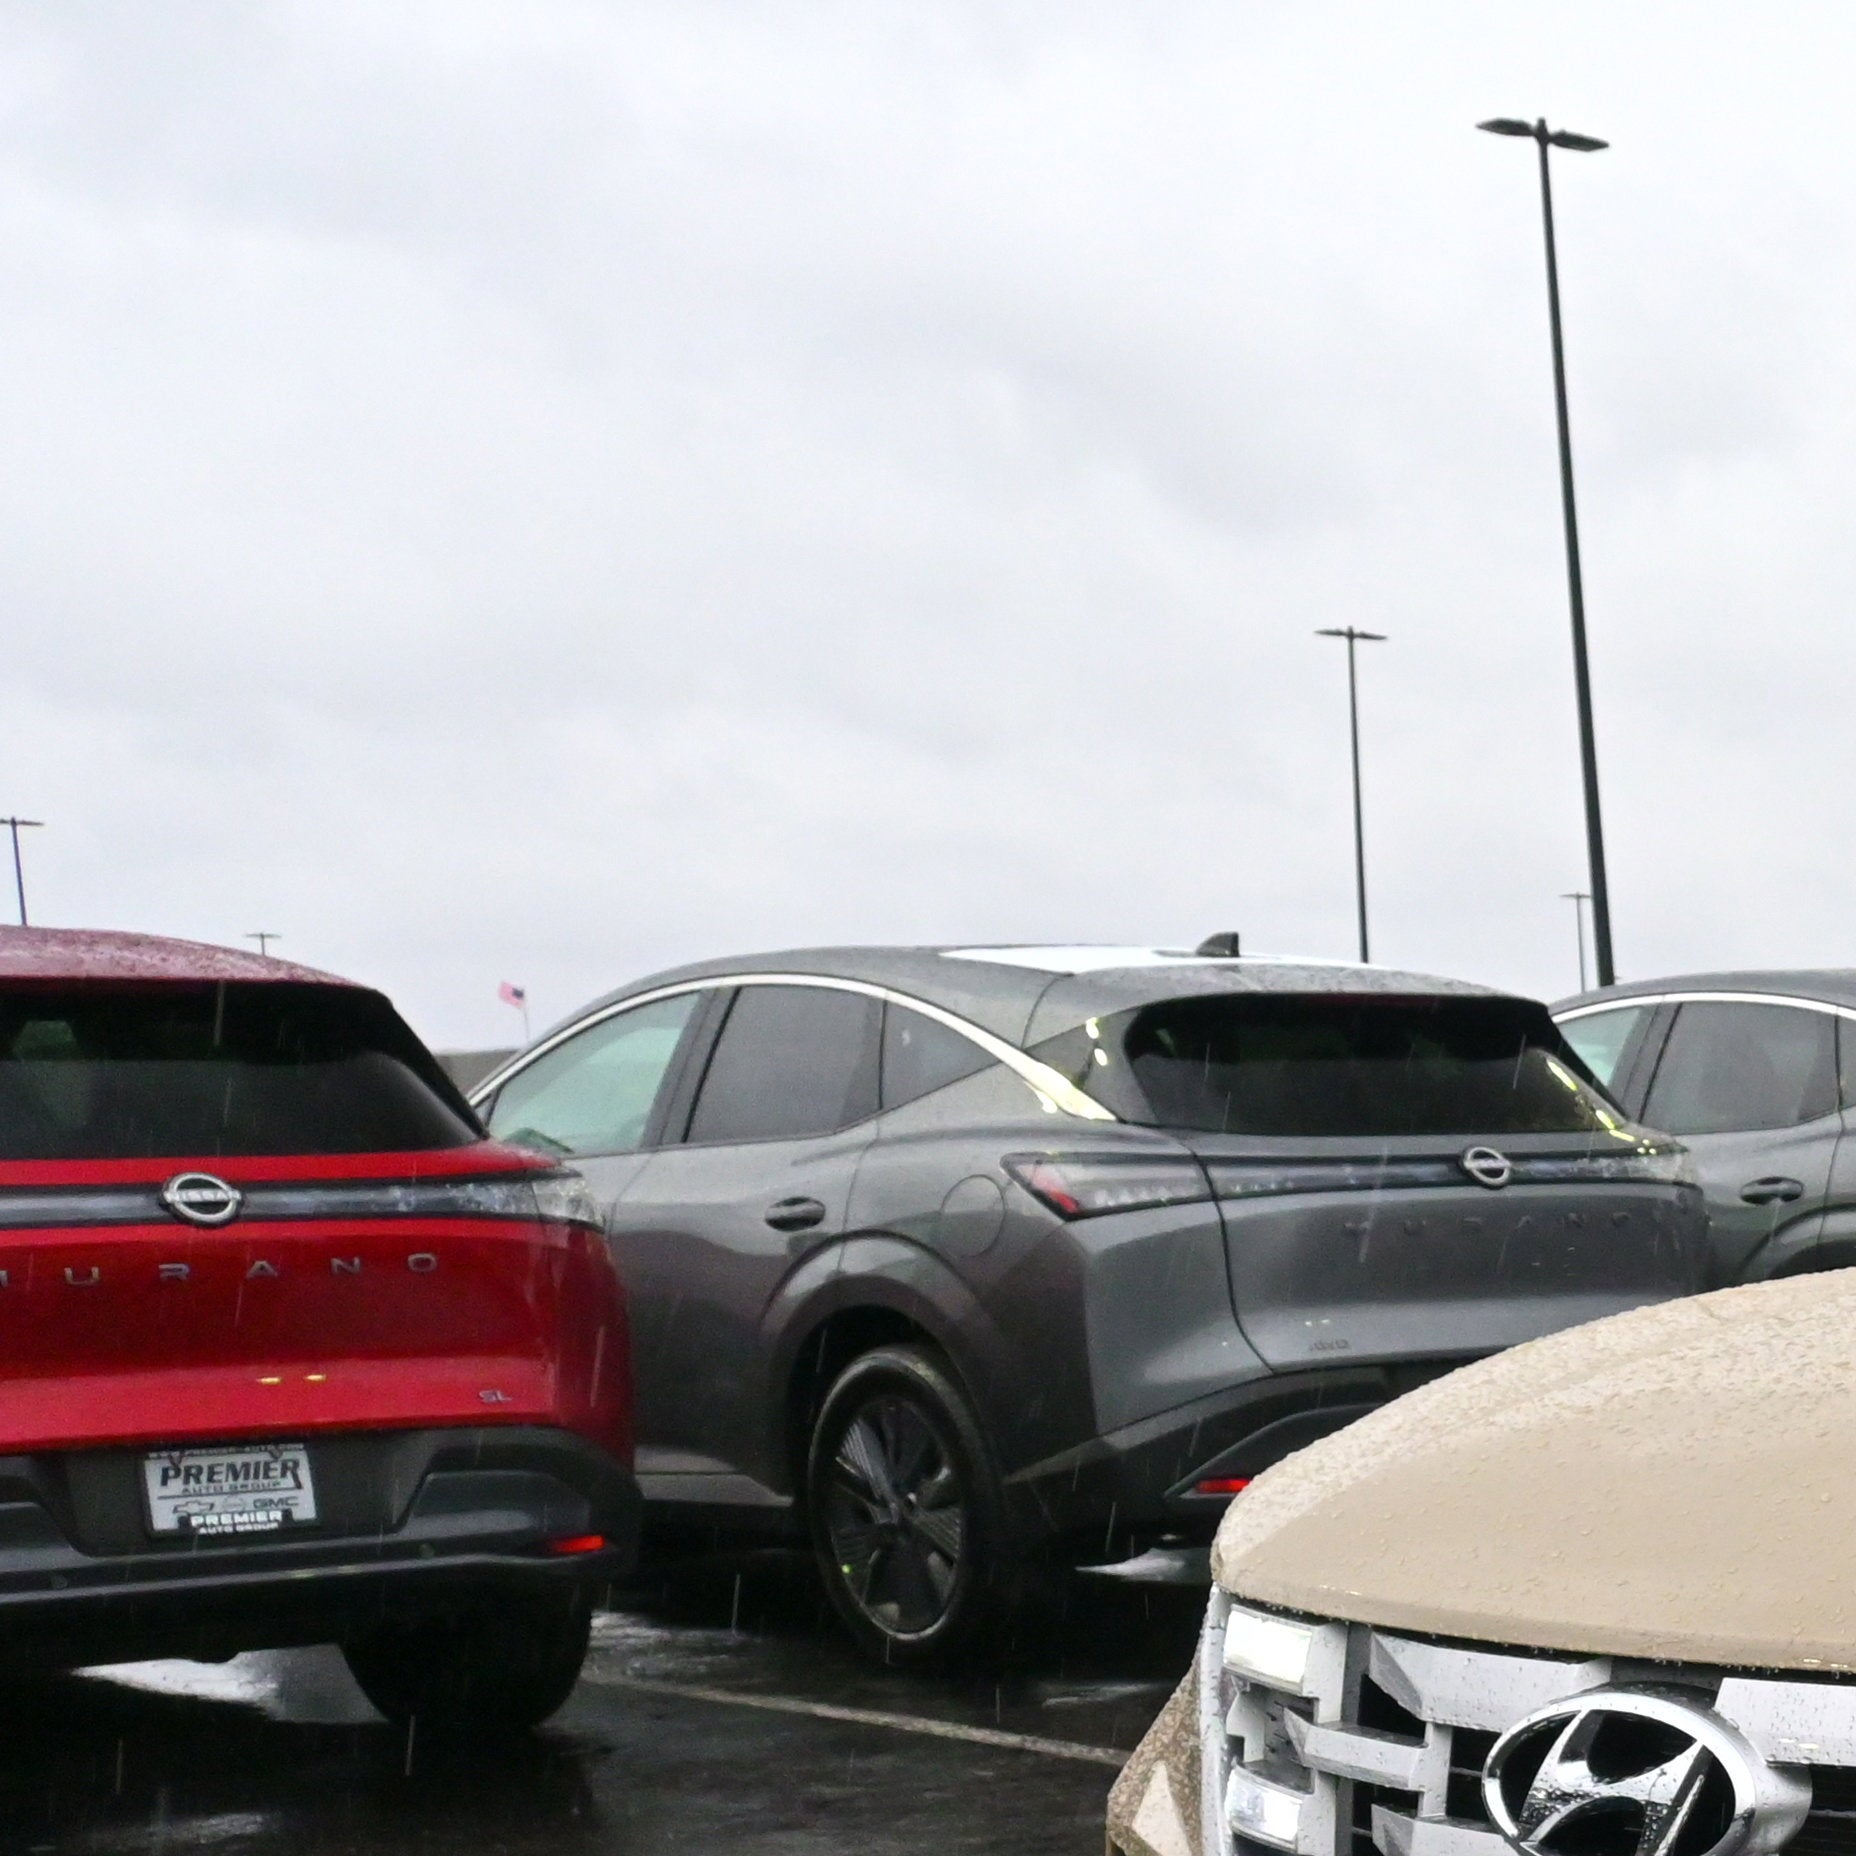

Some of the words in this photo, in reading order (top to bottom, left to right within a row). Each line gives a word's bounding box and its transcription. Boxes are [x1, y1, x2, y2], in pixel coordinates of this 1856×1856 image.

[161, 1459, 303, 1490] PREMIER
[182, 1484, 224, 1495] AUTO
[229, 1481, 281, 1492] GROUP
[254, 1497, 300, 1509] GMC
[191, 1510, 283, 1527] PREMIER
[199, 1525, 234, 1535] AUTO
[236, 1522, 279, 1532] GROUP
